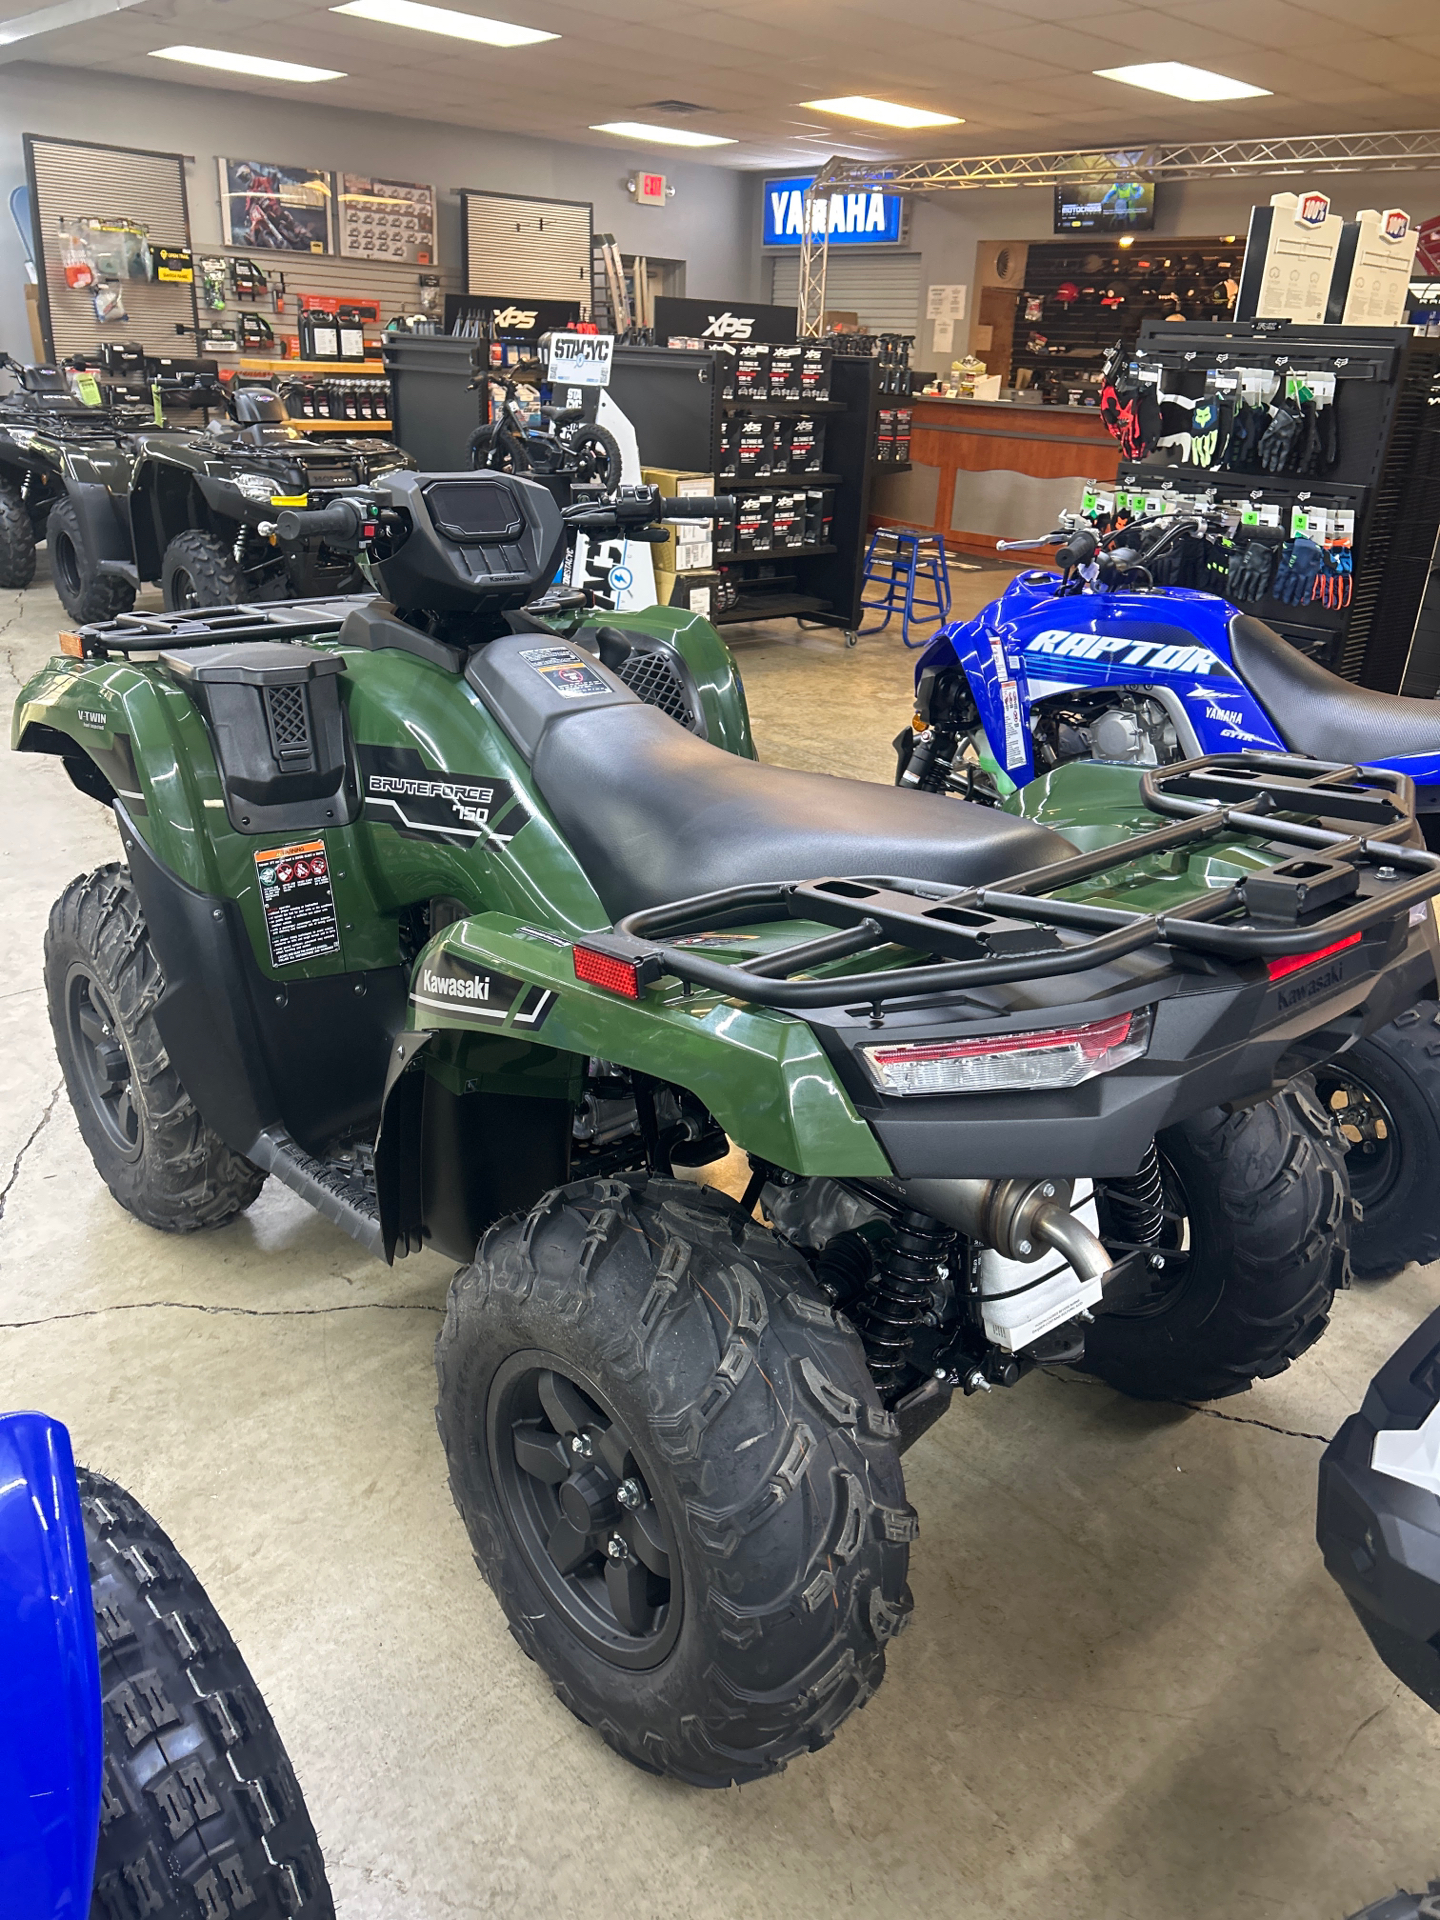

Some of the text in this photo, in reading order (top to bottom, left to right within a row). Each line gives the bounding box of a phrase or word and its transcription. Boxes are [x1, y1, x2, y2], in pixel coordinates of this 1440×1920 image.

[644, 174, 662, 196] EXIT
[770, 191, 886, 235] YAMAHA
[1305, 200, 1328, 221] 100%
[1386, 215, 1409, 236] 100%
[493, 306, 538, 329] XPS
[701, 312, 756, 338] XPS
[554, 338, 610, 361] STACYC
[804, 350, 822, 358] XPS
[742, 422, 762, 432] XPS
[795, 420, 814, 430] XPS
[741, 499, 760, 509] XPS
[776, 496, 794, 506] XPS
[1026, 630, 1220, 676] RAPTOR
[78, 710, 107, 724] V-TWIN
[1205, 706, 1243, 724] YAMAHA
[1220, 729, 1255, 742] GYTR
[452, 804, 489, 823] 750
[424, 970, 490, 1000] Kawasaki
[1278, 961, 1343, 1011] Kawasaki
